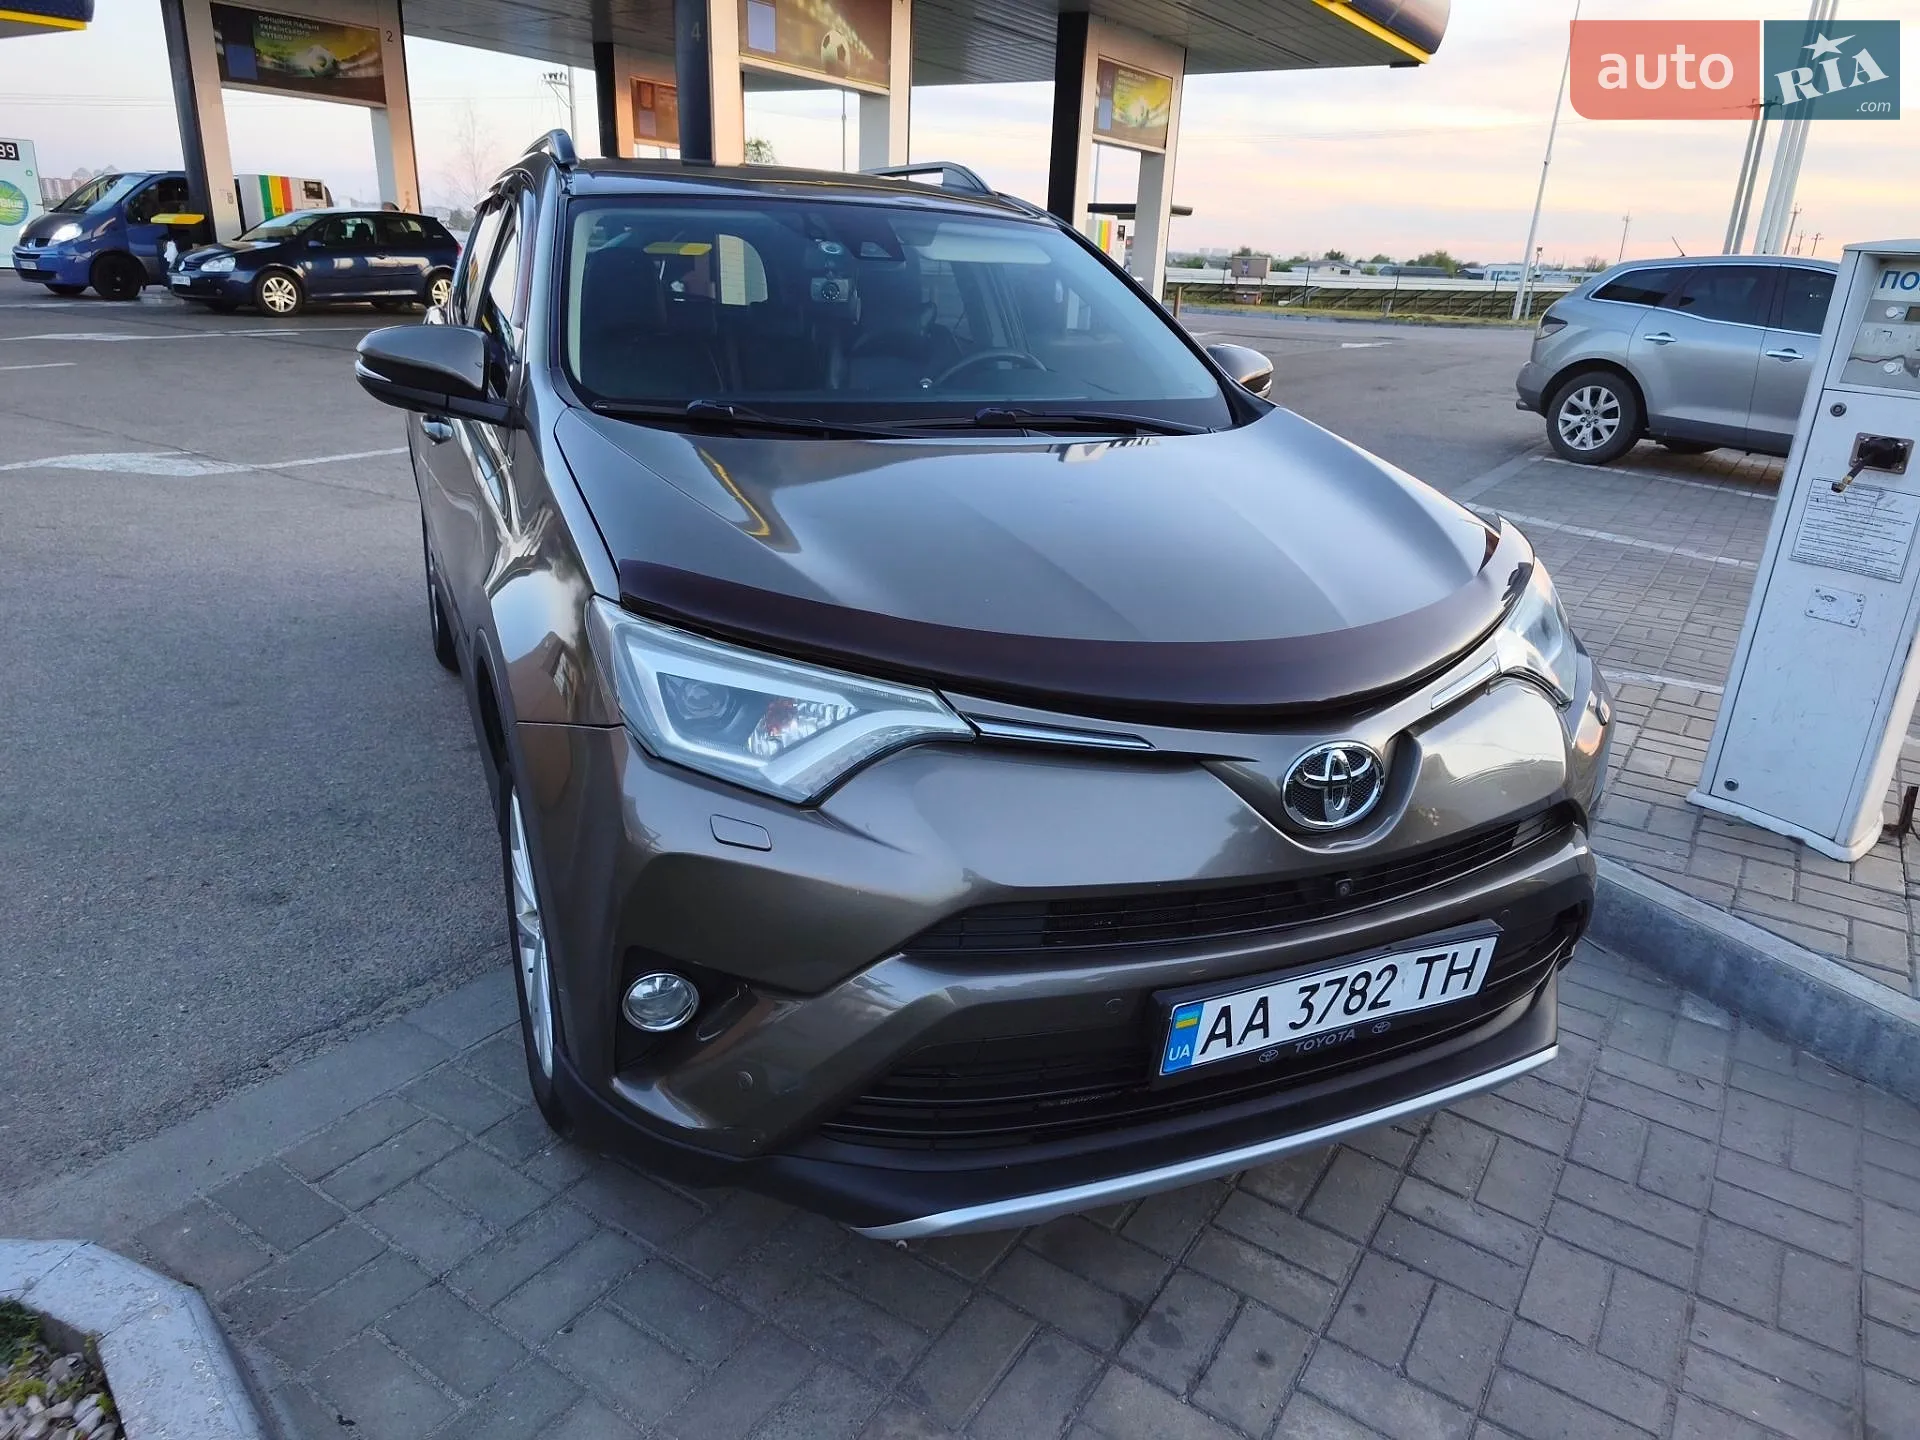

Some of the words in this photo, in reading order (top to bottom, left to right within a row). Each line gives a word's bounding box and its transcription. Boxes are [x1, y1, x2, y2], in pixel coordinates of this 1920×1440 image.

[386, 30, 393, 42] 2
[691, 21, 701, 41] 4
[1880, 270, 1920, 291] ПО
[1200, 996, 1270, 1056] AA
[1288, 963, 1398, 1031] 3782
[1415, 947, 1482, 1000] TH
[1295, 1028, 1356, 1054] TOYOTA
[1168, 1043, 1191, 1061] UA
